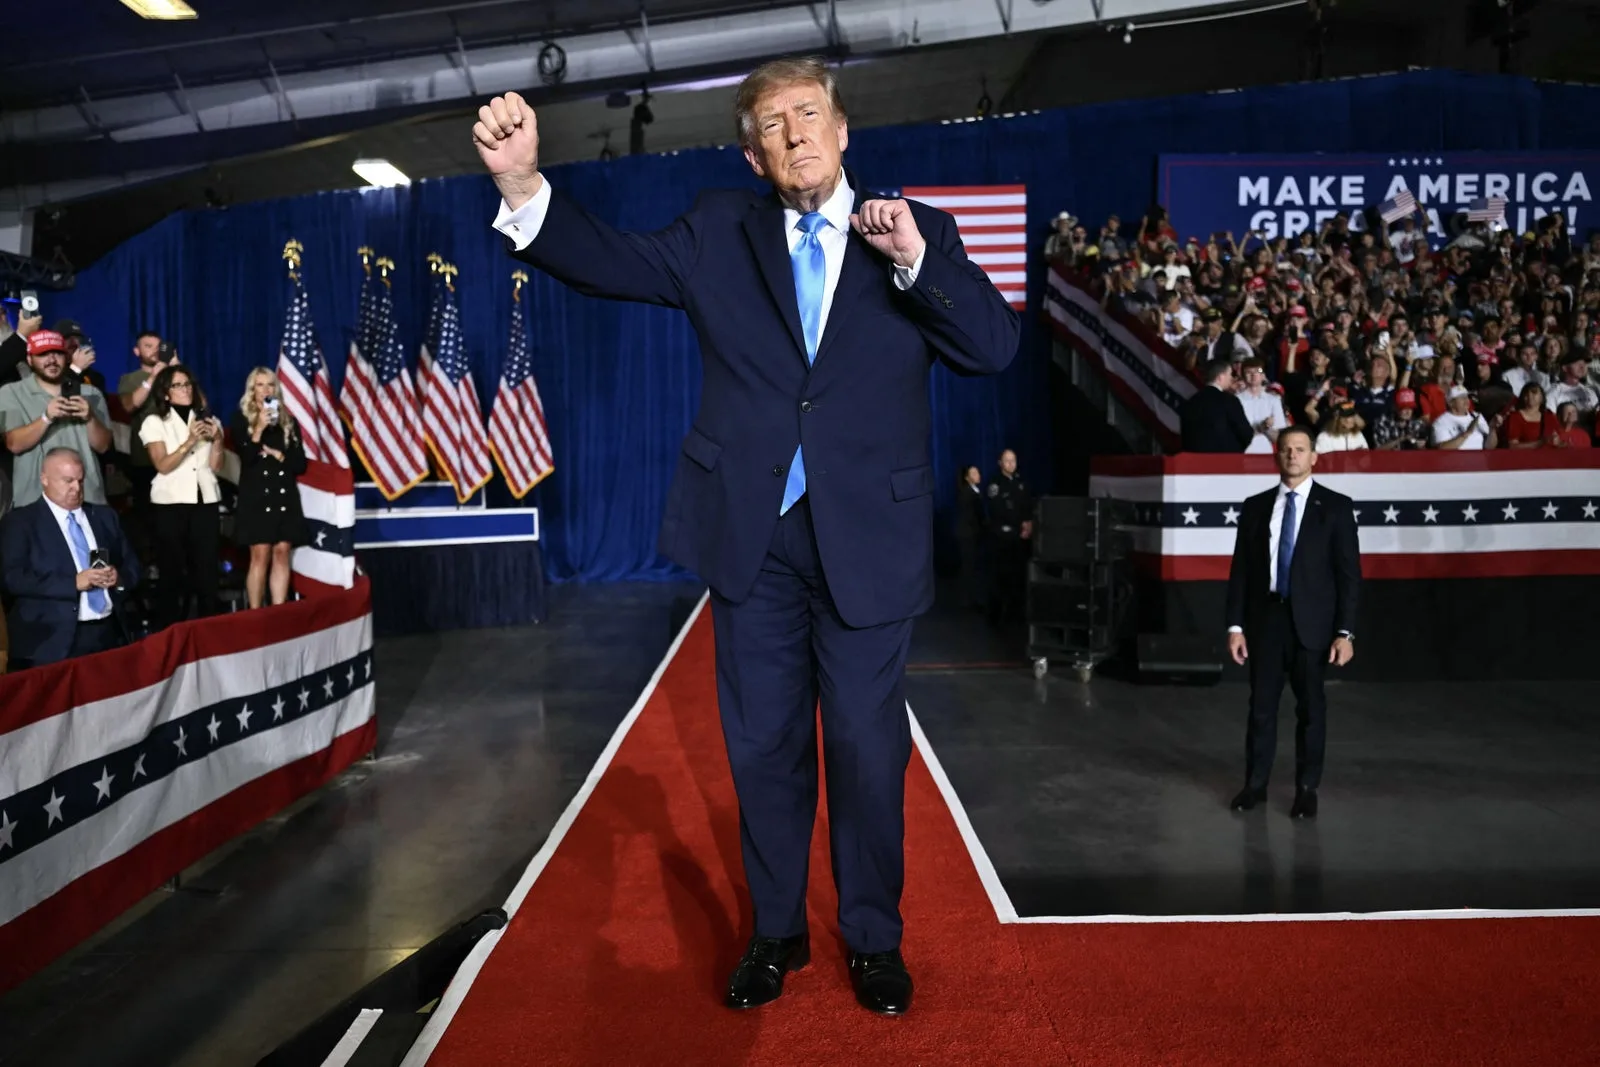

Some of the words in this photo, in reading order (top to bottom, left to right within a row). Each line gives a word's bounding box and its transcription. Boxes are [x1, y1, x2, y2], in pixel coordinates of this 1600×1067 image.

[1238, 175, 1365, 206] MAKE
[1384, 171, 1592, 204] AMERICA
[1250, 208, 1369, 241] GREA
